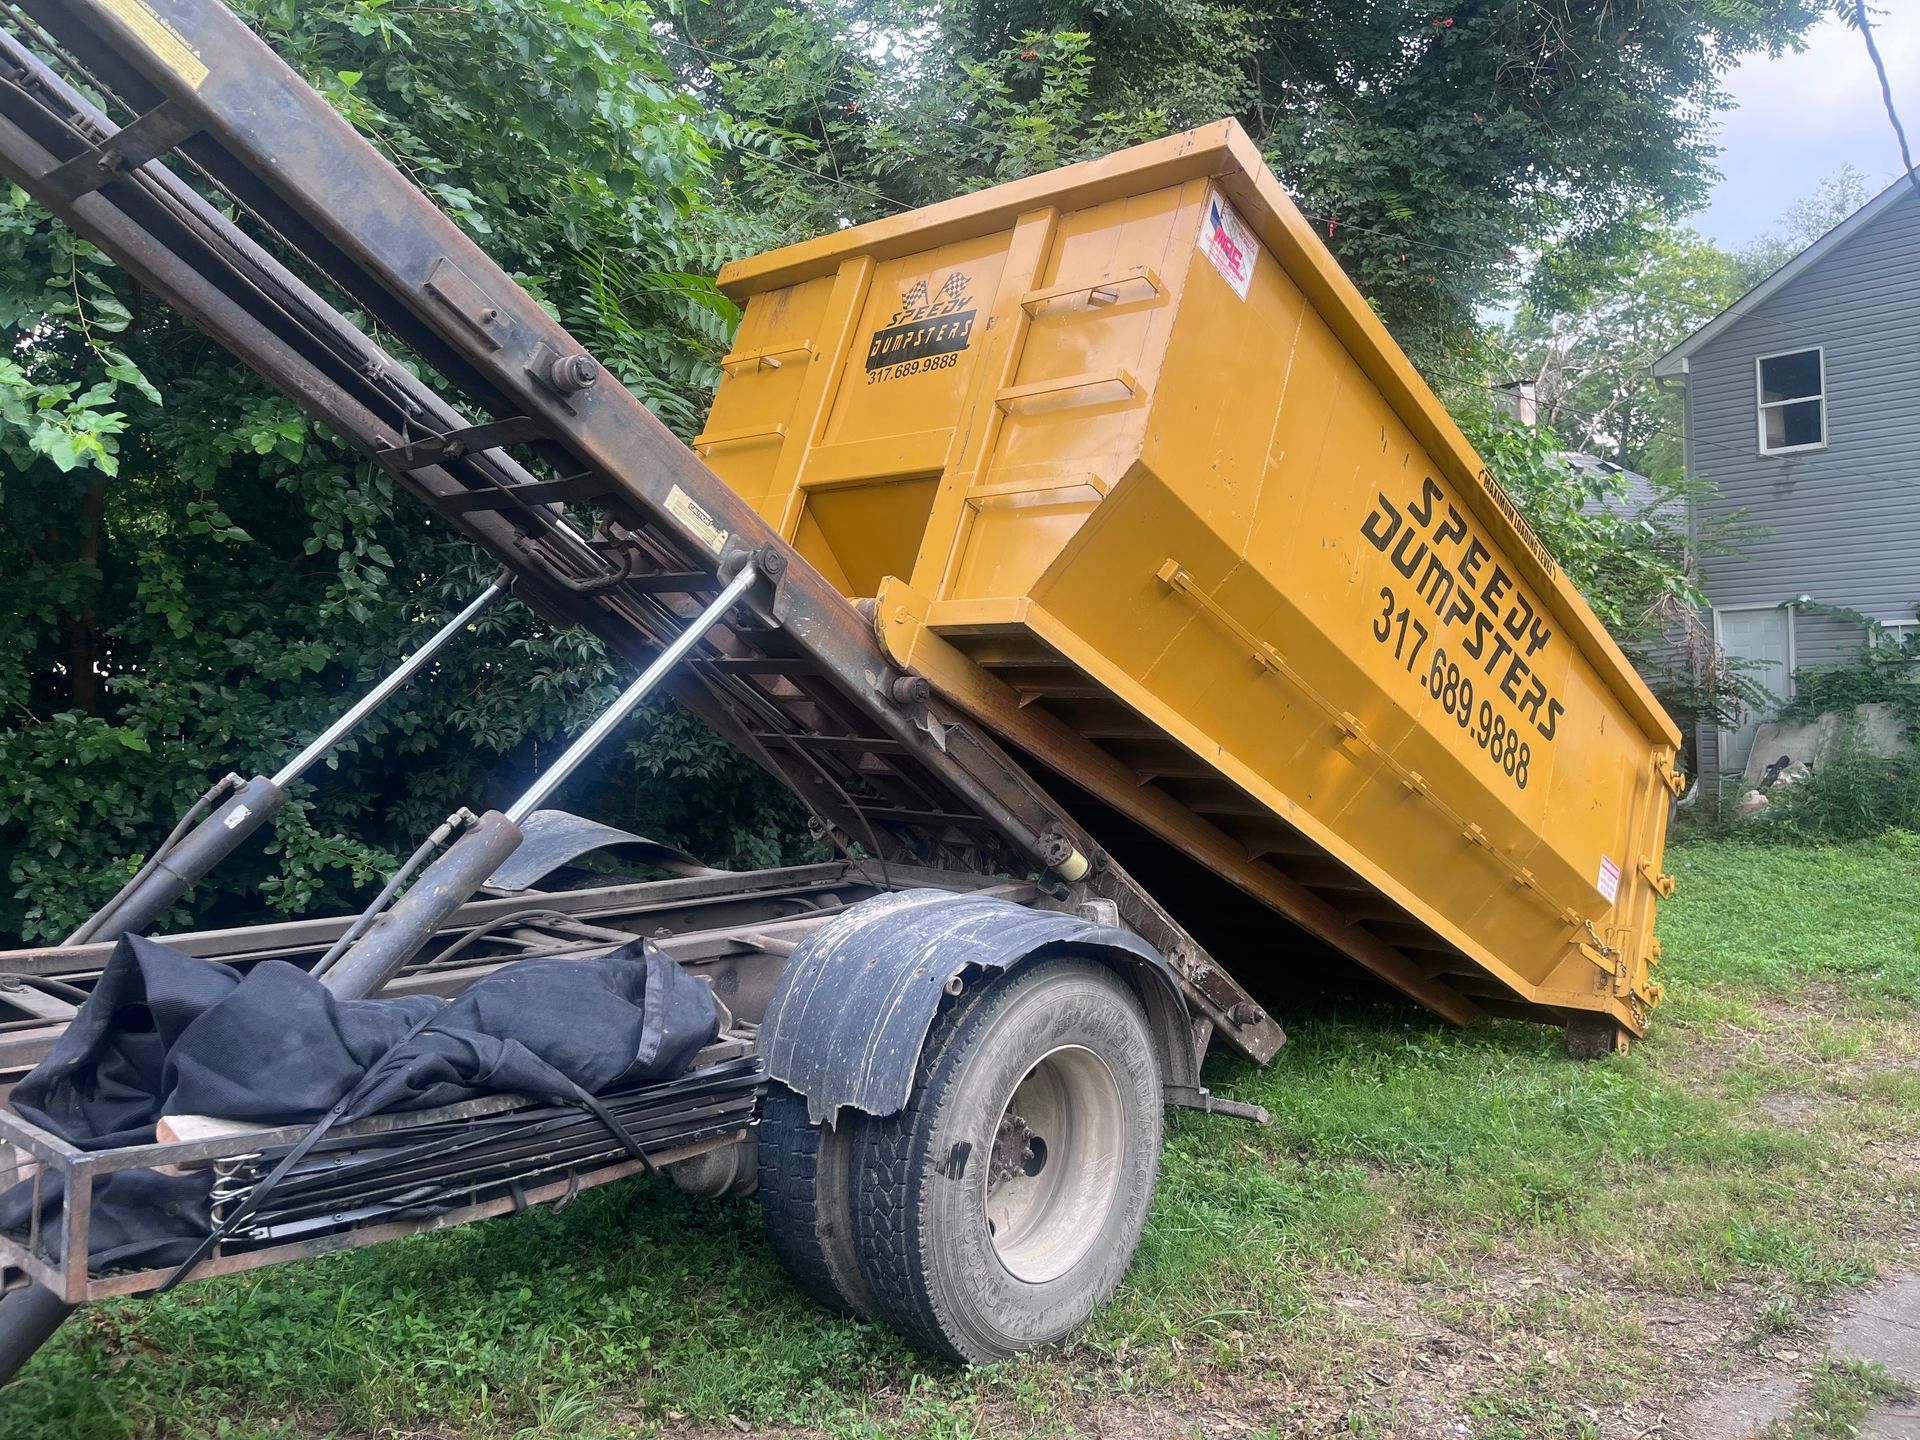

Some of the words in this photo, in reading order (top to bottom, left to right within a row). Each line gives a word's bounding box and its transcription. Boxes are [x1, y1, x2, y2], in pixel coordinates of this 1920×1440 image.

[160, 17, 194, 51] WARNING
[887, 296, 974, 327] SPEEDY
[870, 319, 972, 357] DUMPSTERS
[867, 353, 958, 385] 317.689.9888
[688, 503, 711, 526] CAUTION
[1483, 474, 1515, 520] MAXIMUM
[1513, 510, 1539, 556] LOADING
[1537, 547, 1553, 577] LEVEL
[1407, 476, 1552, 657] SPEEDY
[1360, 491, 1565, 741] DUMPSTERS
[1373, 587, 1531, 789] 317.689.9888
